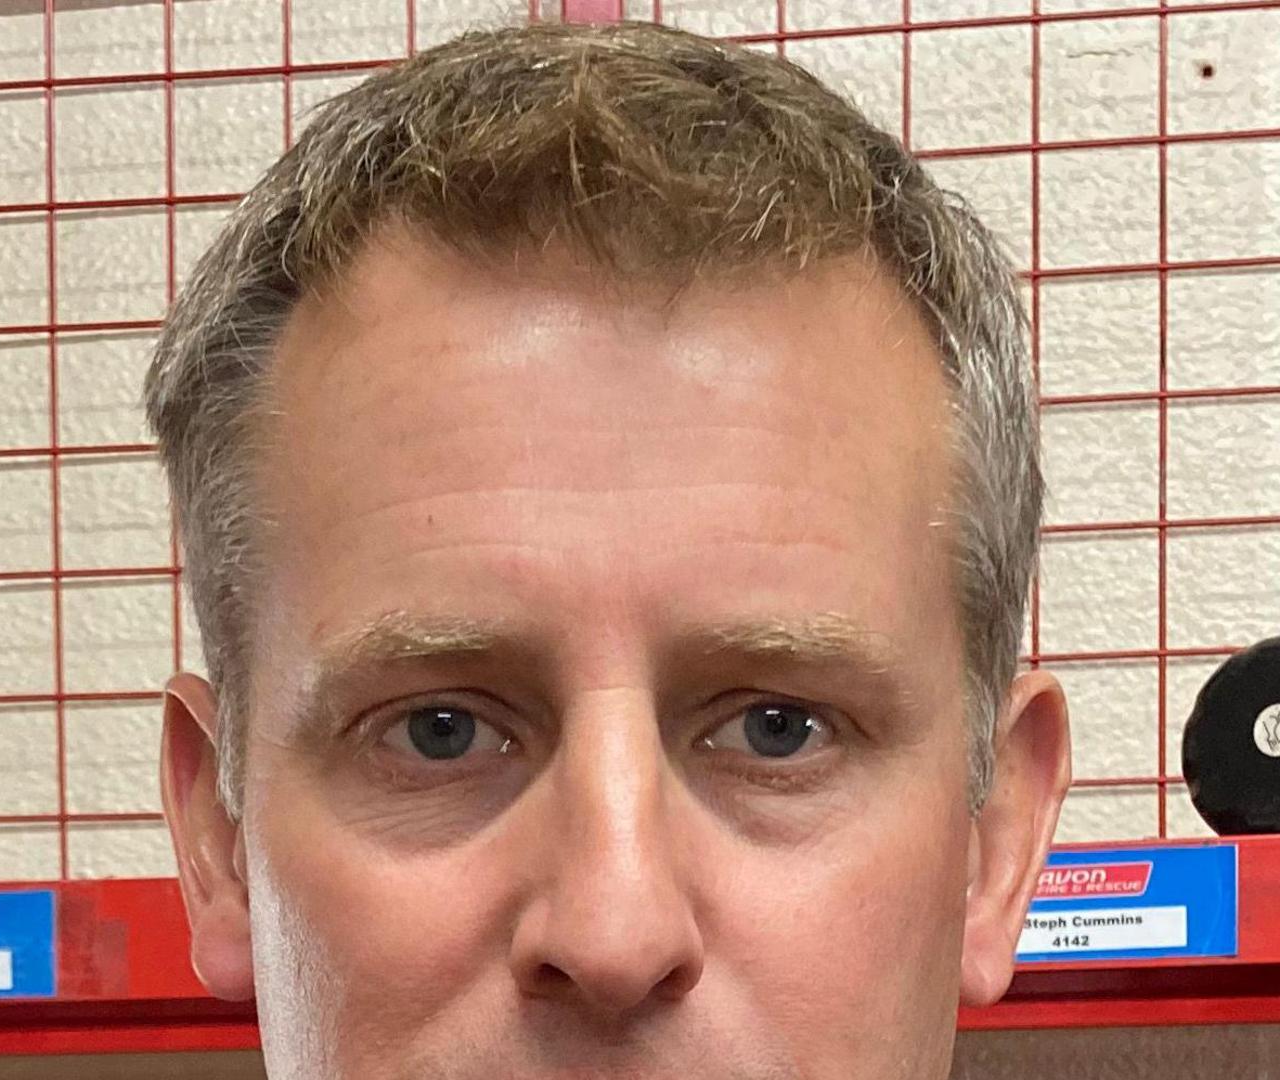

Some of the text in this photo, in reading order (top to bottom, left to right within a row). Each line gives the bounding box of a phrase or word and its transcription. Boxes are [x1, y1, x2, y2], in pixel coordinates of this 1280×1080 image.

[1038, 869, 1107, 886] AVON
[1036, 884, 1070, 895] FIRE
[1086, 881, 1142, 893] RESCUE
[1024, 914, 1143, 931] Steph Cummins
[1052, 935, 1090, 948] 4142
